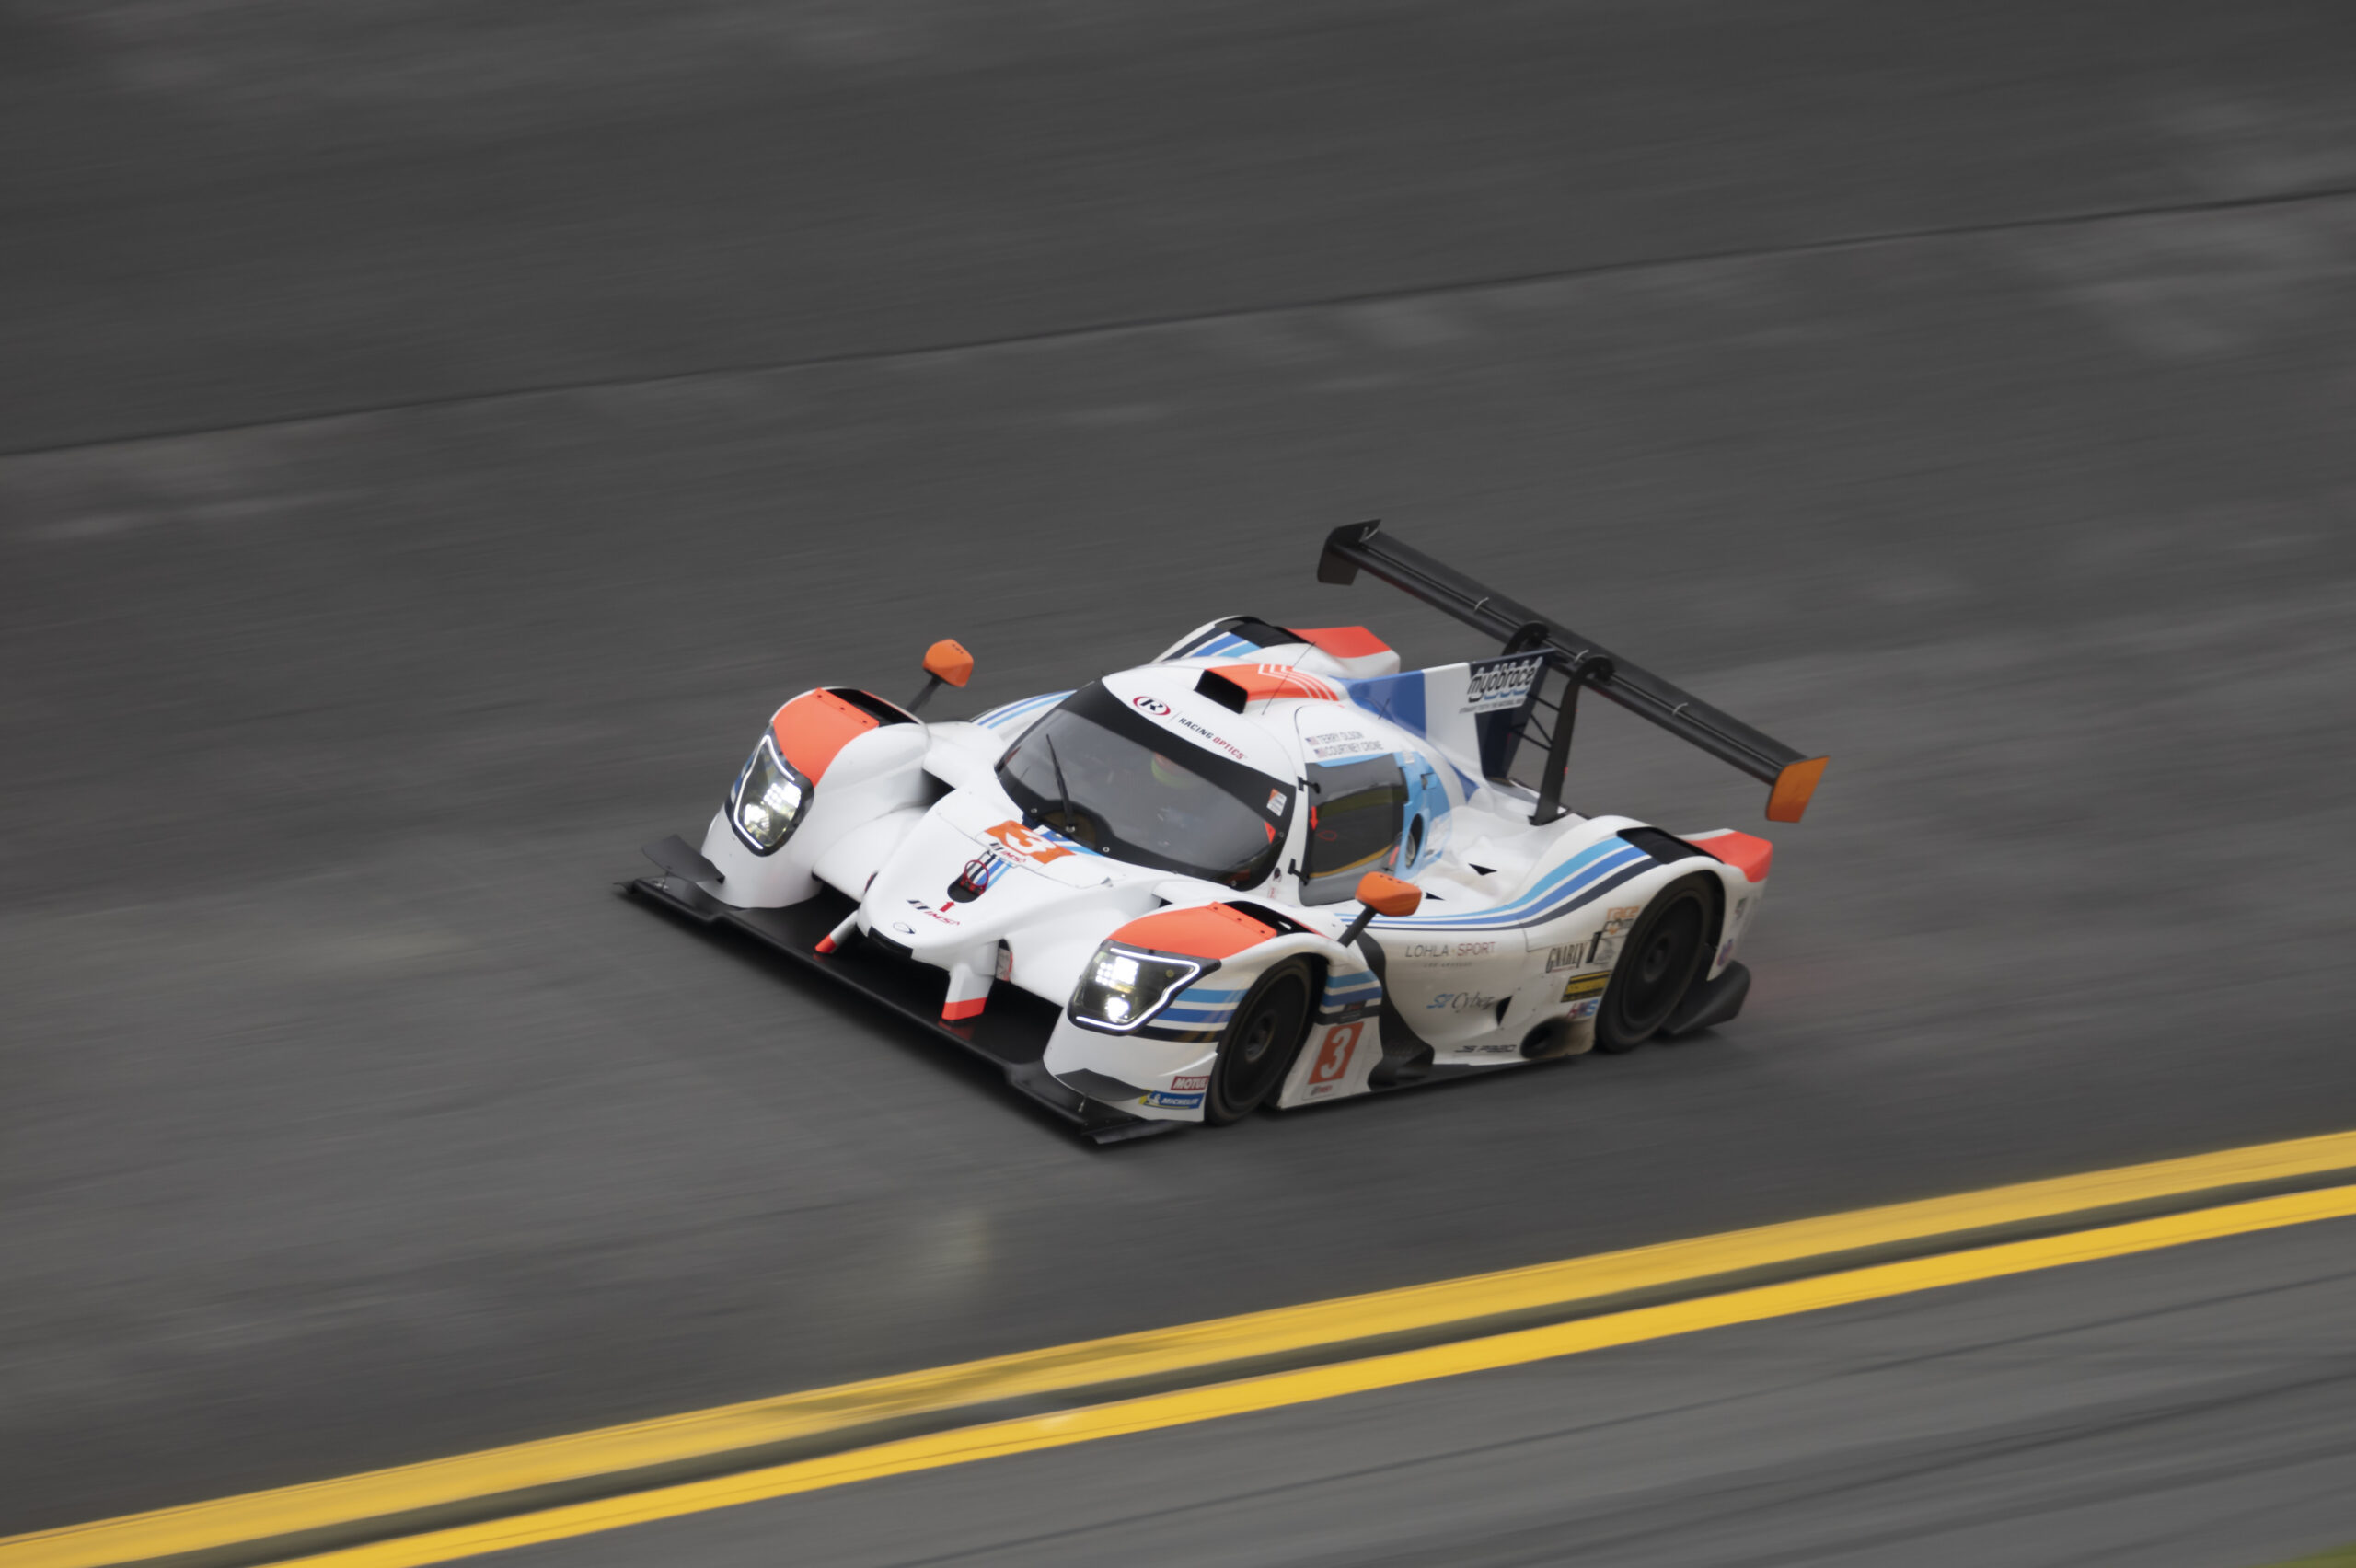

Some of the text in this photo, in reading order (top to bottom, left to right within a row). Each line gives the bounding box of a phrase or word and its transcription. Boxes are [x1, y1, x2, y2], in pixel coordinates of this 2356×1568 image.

[1467, 663, 1536, 703] myobrace
[1178, 718, 1245, 760] RACING OPTICS
[1005, 829, 1057, 854] 3
[924, 911, 960, 925] IMSA
[1405, 941, 1496, 957] LOHLA SPORT
[1546, 942, 1587, 973] GNARLY
[1320, 1027, 1353, 1078] 3
[1173, 1078, 1207, 1090] MOTUL
[1161, 1097, 1199, 1105] MICHELIN
